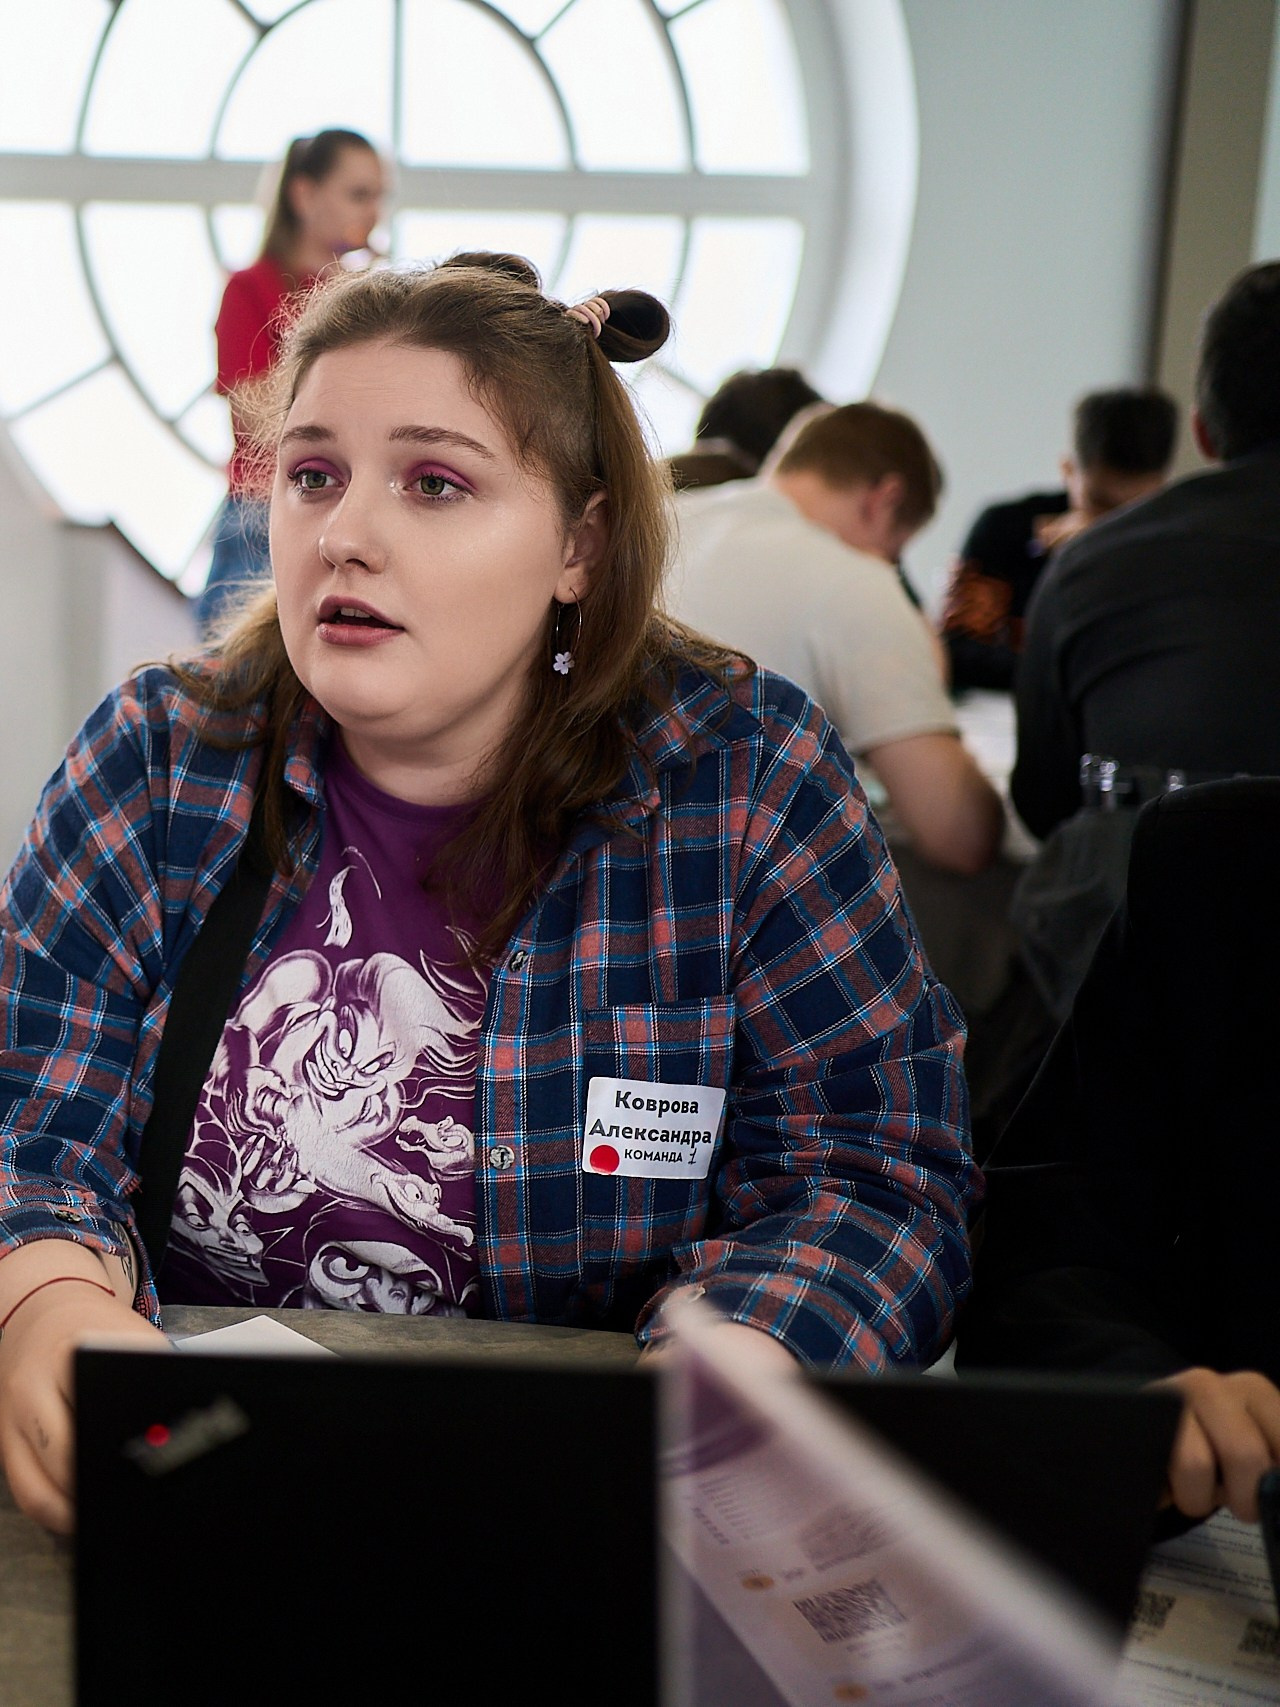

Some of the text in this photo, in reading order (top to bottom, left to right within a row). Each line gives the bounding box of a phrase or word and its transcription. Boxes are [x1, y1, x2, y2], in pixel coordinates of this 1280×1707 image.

[615, 1090, 699, 1118] Коврова
[588, 1118, 712, 1148] Александра
[624, 1148, 683, 1163] КОМАНДА
